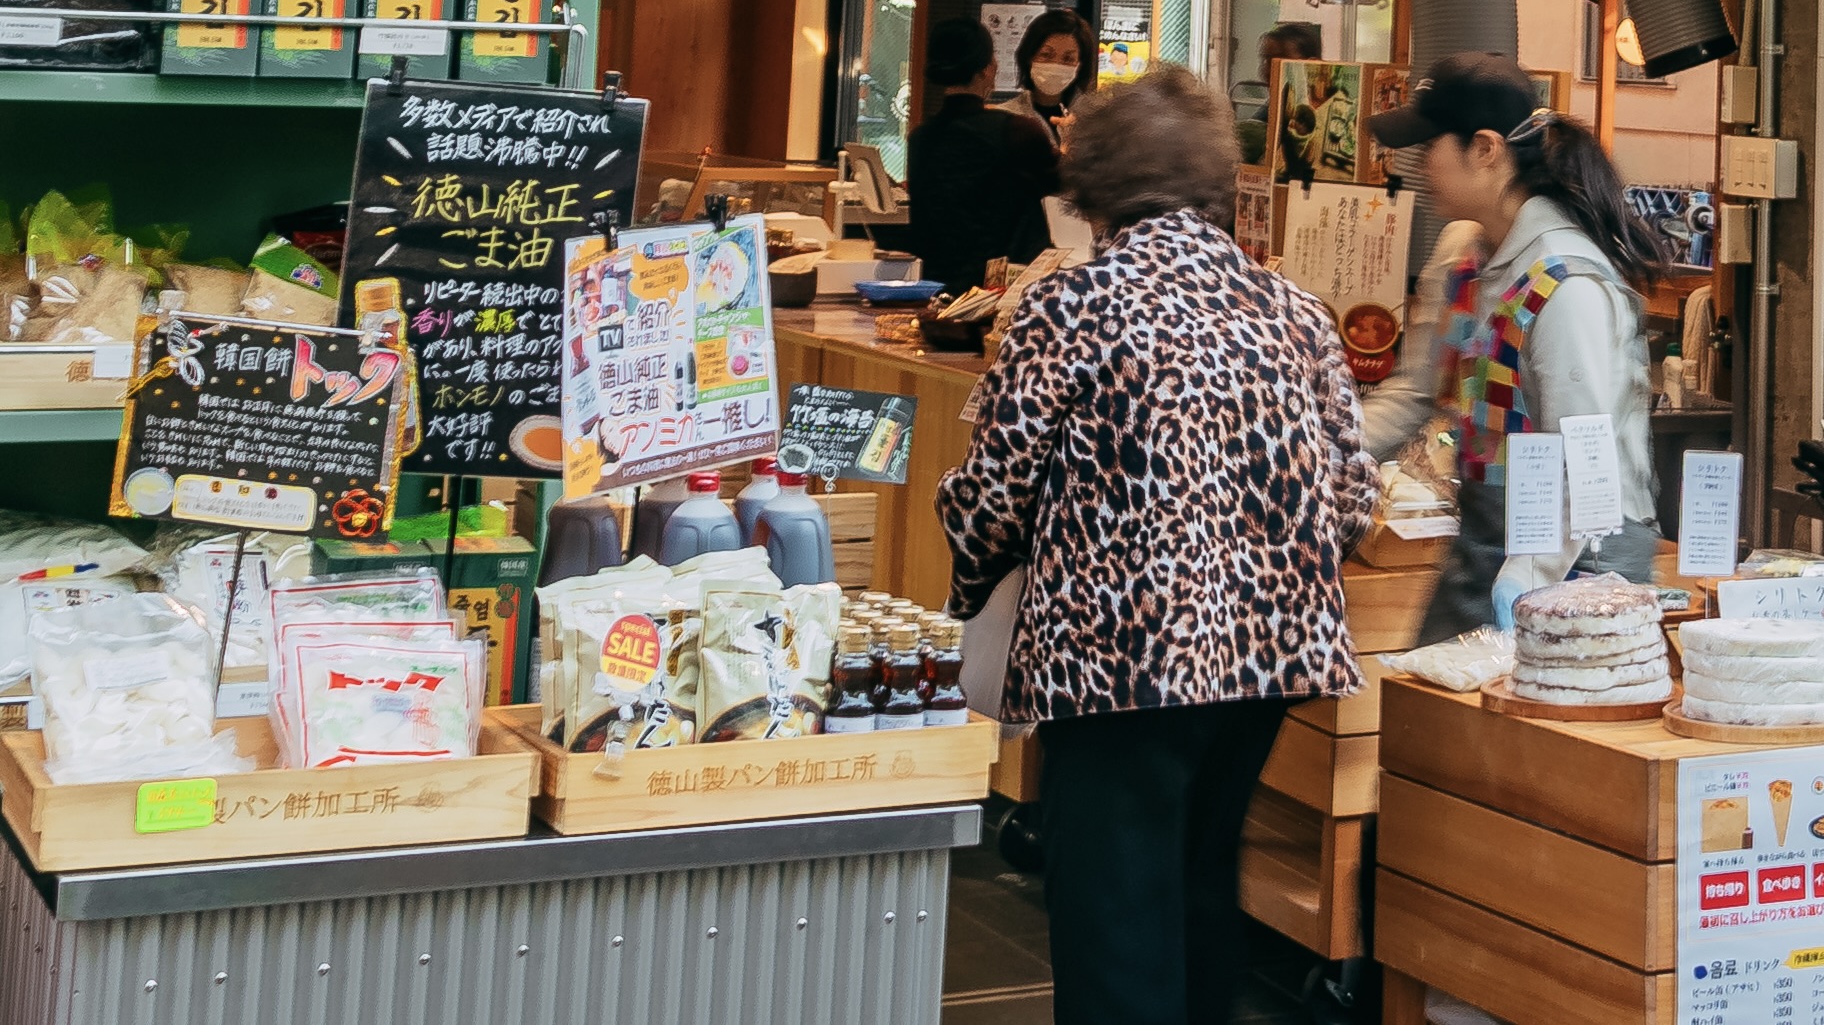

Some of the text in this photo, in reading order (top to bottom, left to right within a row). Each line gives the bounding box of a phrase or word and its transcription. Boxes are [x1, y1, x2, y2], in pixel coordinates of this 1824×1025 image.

[399, 94, 612, 140] 多数メディアで紹介され
[411, 173, 585, 225] 徳山純正
[438, 225, 555, 271] ごま油
[600, 329, 623, 350] TV
[213, 334, 401, 408] 韓国餅 トック
[607, 631, 656, 665] SALE
[327, 669, 446, 693] トック
[646, 751, 880, 798] 徳山製パン餅加工所
[1709, 959, 1738, 980] 음료
